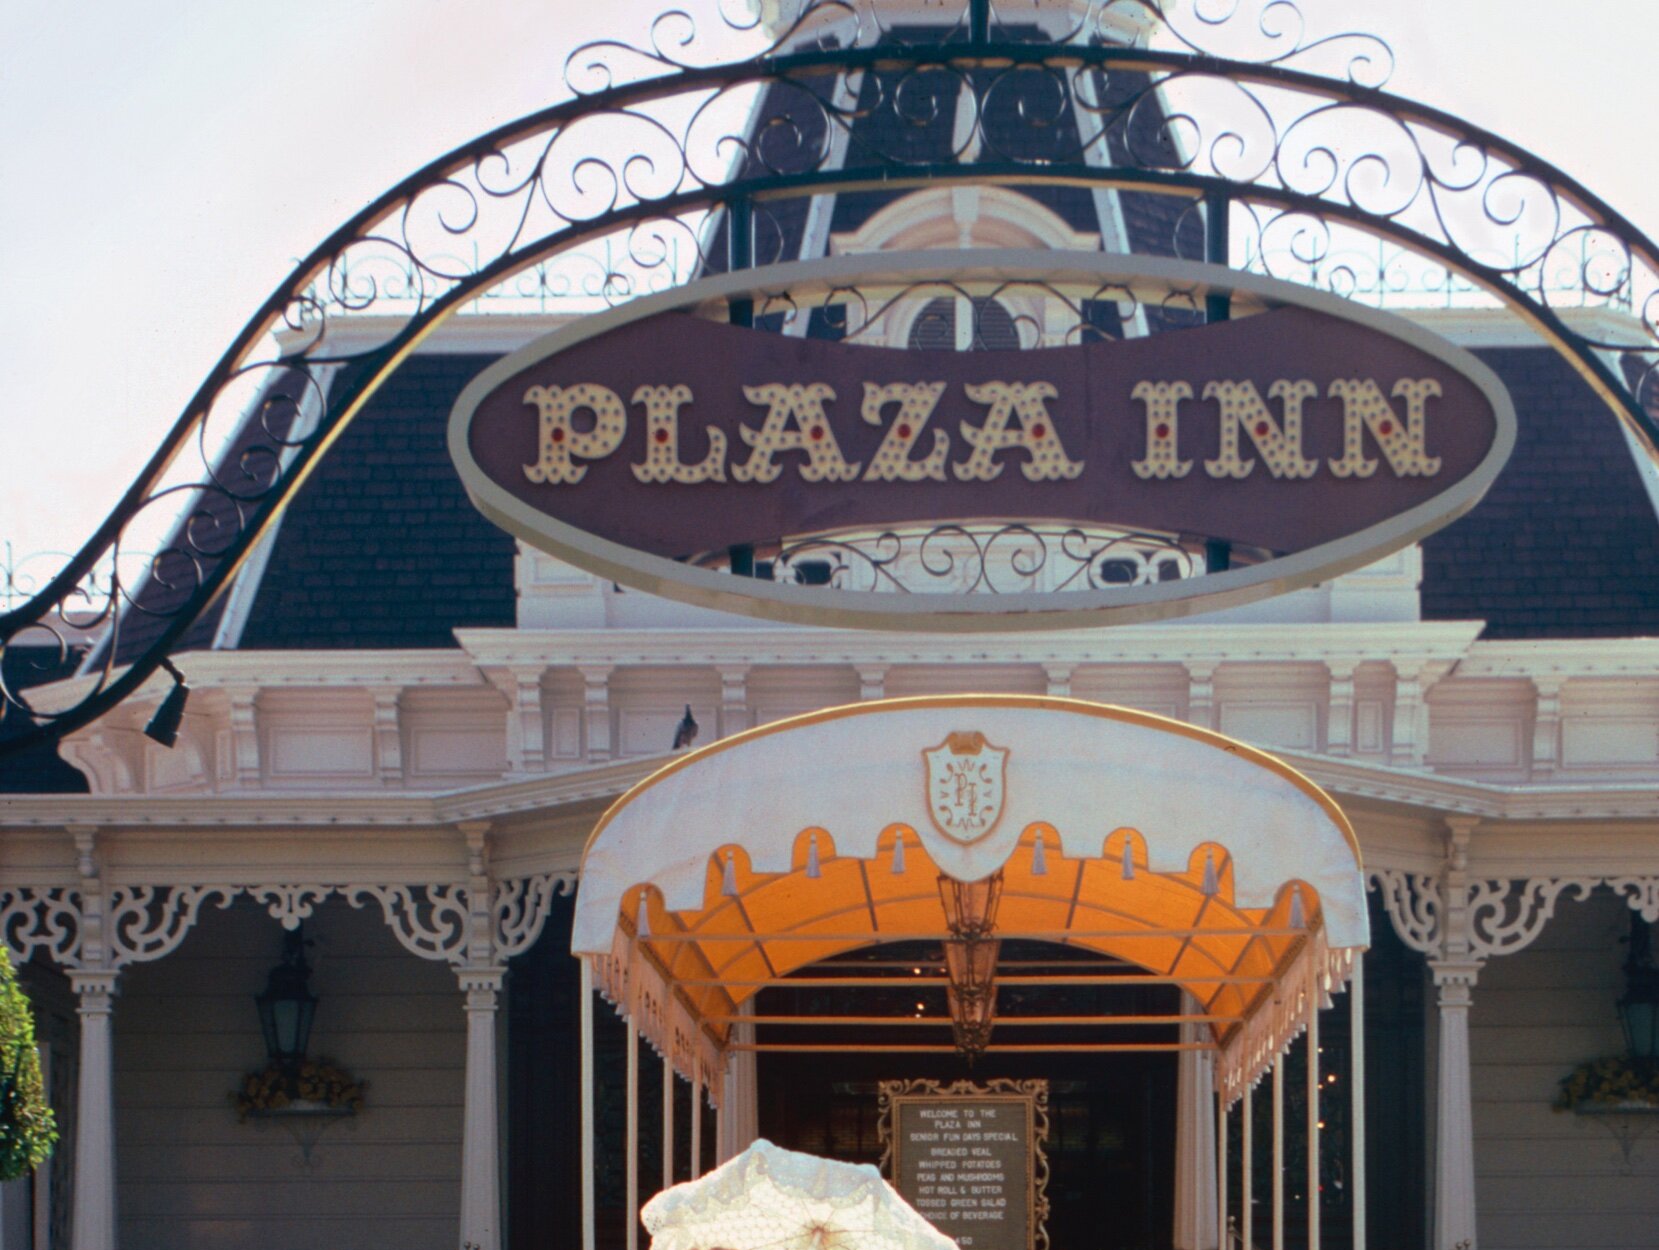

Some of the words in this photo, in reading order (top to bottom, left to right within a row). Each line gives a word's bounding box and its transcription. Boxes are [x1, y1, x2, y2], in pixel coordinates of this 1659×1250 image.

[522, 379, 1085, 485] PLAZA
[1130, 378, 1442, 480] INN
[920, 1109, 958, 1118] WELCOME
[964, 1109, 975, 1118] TO
[980, 1109, 996, 1118] THE
[935, 1120, 961, 1129] PLAZA
[967, 1120, 982, 1129] INN
[910, 1133, 939, 1142] SENIOR
[943, 1133, 961, 1142] FUN
[963, 1133, 981, 1142] DAYS
[983, 1133, 1019, 1142] SPECIAL
[931, 1147, 968, 1156] BREADED
[971, 1147, 992, 1156] VEAL
[918, 1160, 957, 1169] WHIPPED
[962, 1160, 1002, 1169] POTATOES
[917, 1173, 936, 1182] PEAS
[940, 1173, 954, 1182] AND
[957, 1173, 1005, 1182] MUSHROOMS
[919, 1186, 935, 1195] HOT
[937, 1186, 958, 1195] ROLL
[960, 1186, 966, 1195] &
[971, 1186, 1002, 1195] BUTTER
[916, 1198, 947, 1207] TOSSED
[950, 1198, 978, 1207] GREEN
[981, 1198, 1006, 1207] SALAD
[950, 1211, 961, 1220] OF
[962, 1211, 1004, 1220] BEVERAGE
